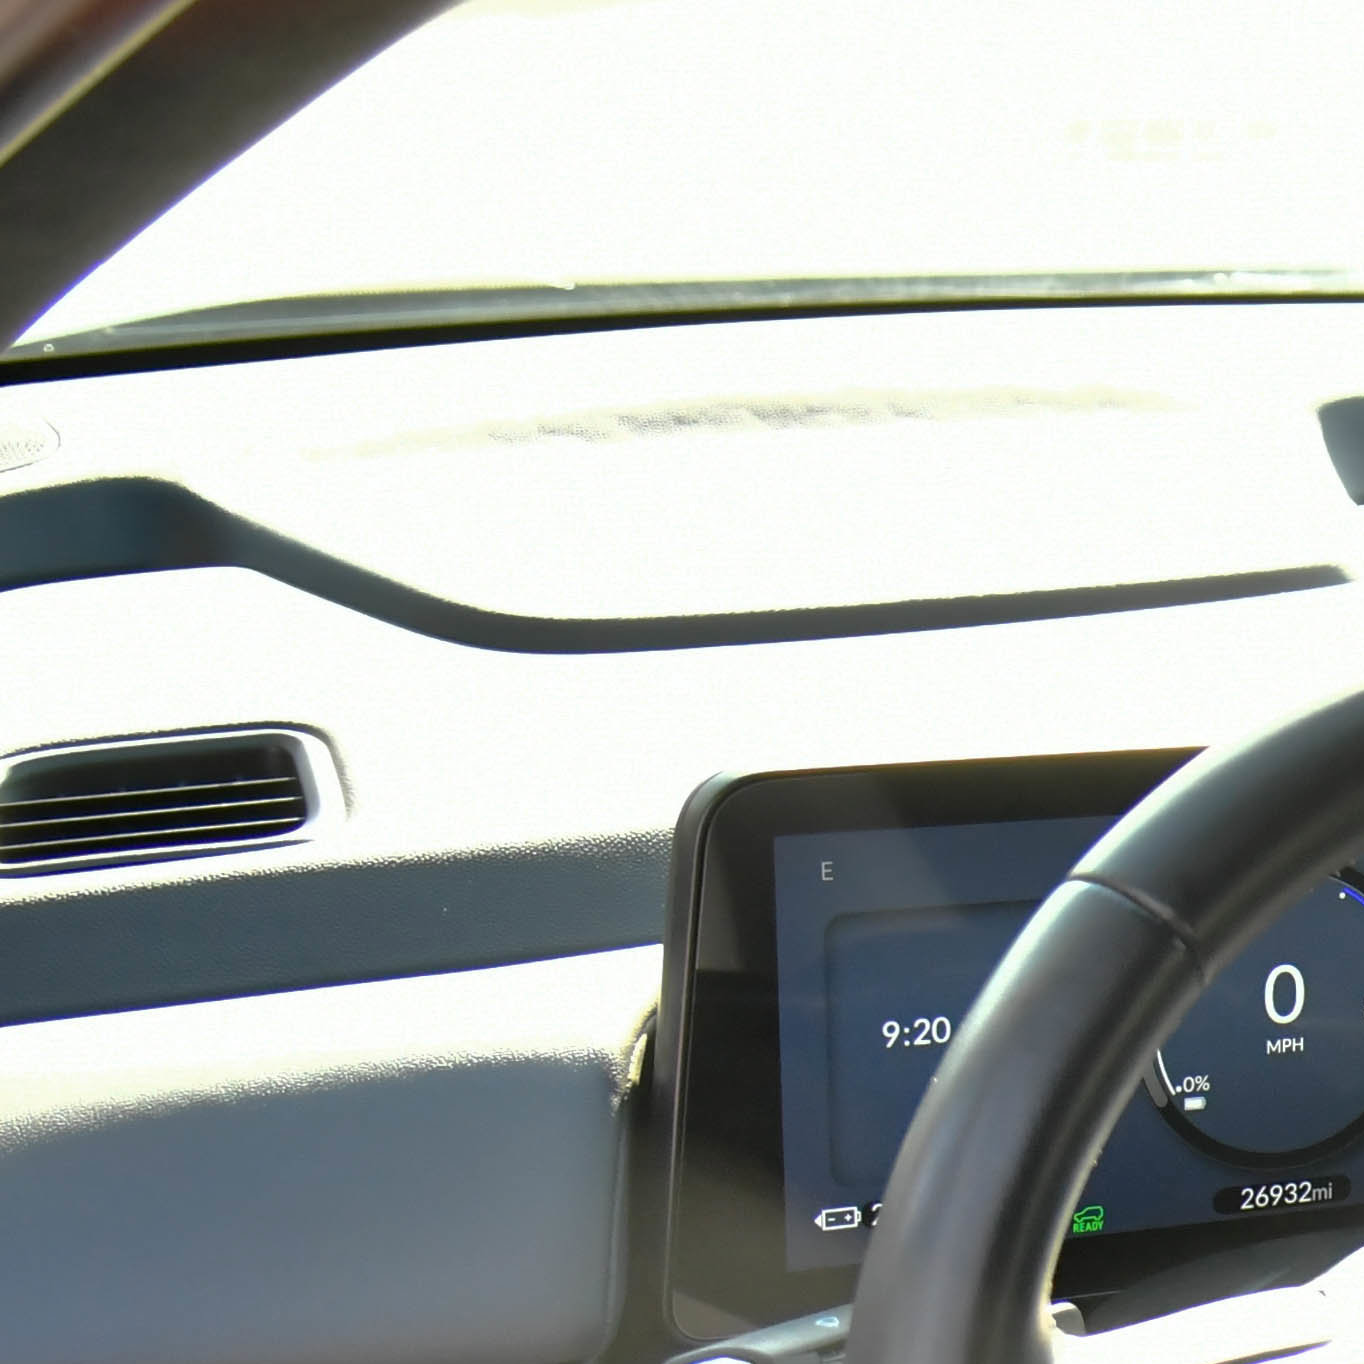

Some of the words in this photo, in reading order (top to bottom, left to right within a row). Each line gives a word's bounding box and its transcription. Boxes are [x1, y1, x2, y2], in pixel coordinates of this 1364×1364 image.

[820, 861, 834, 882] E
[1264, 963, 1306, 1025] 0
[881, 1016, 952, 1050] 9:20
[1266, 1037, 1305, 1056] MPH
[1073, 1221, 1104, 1233] READY
